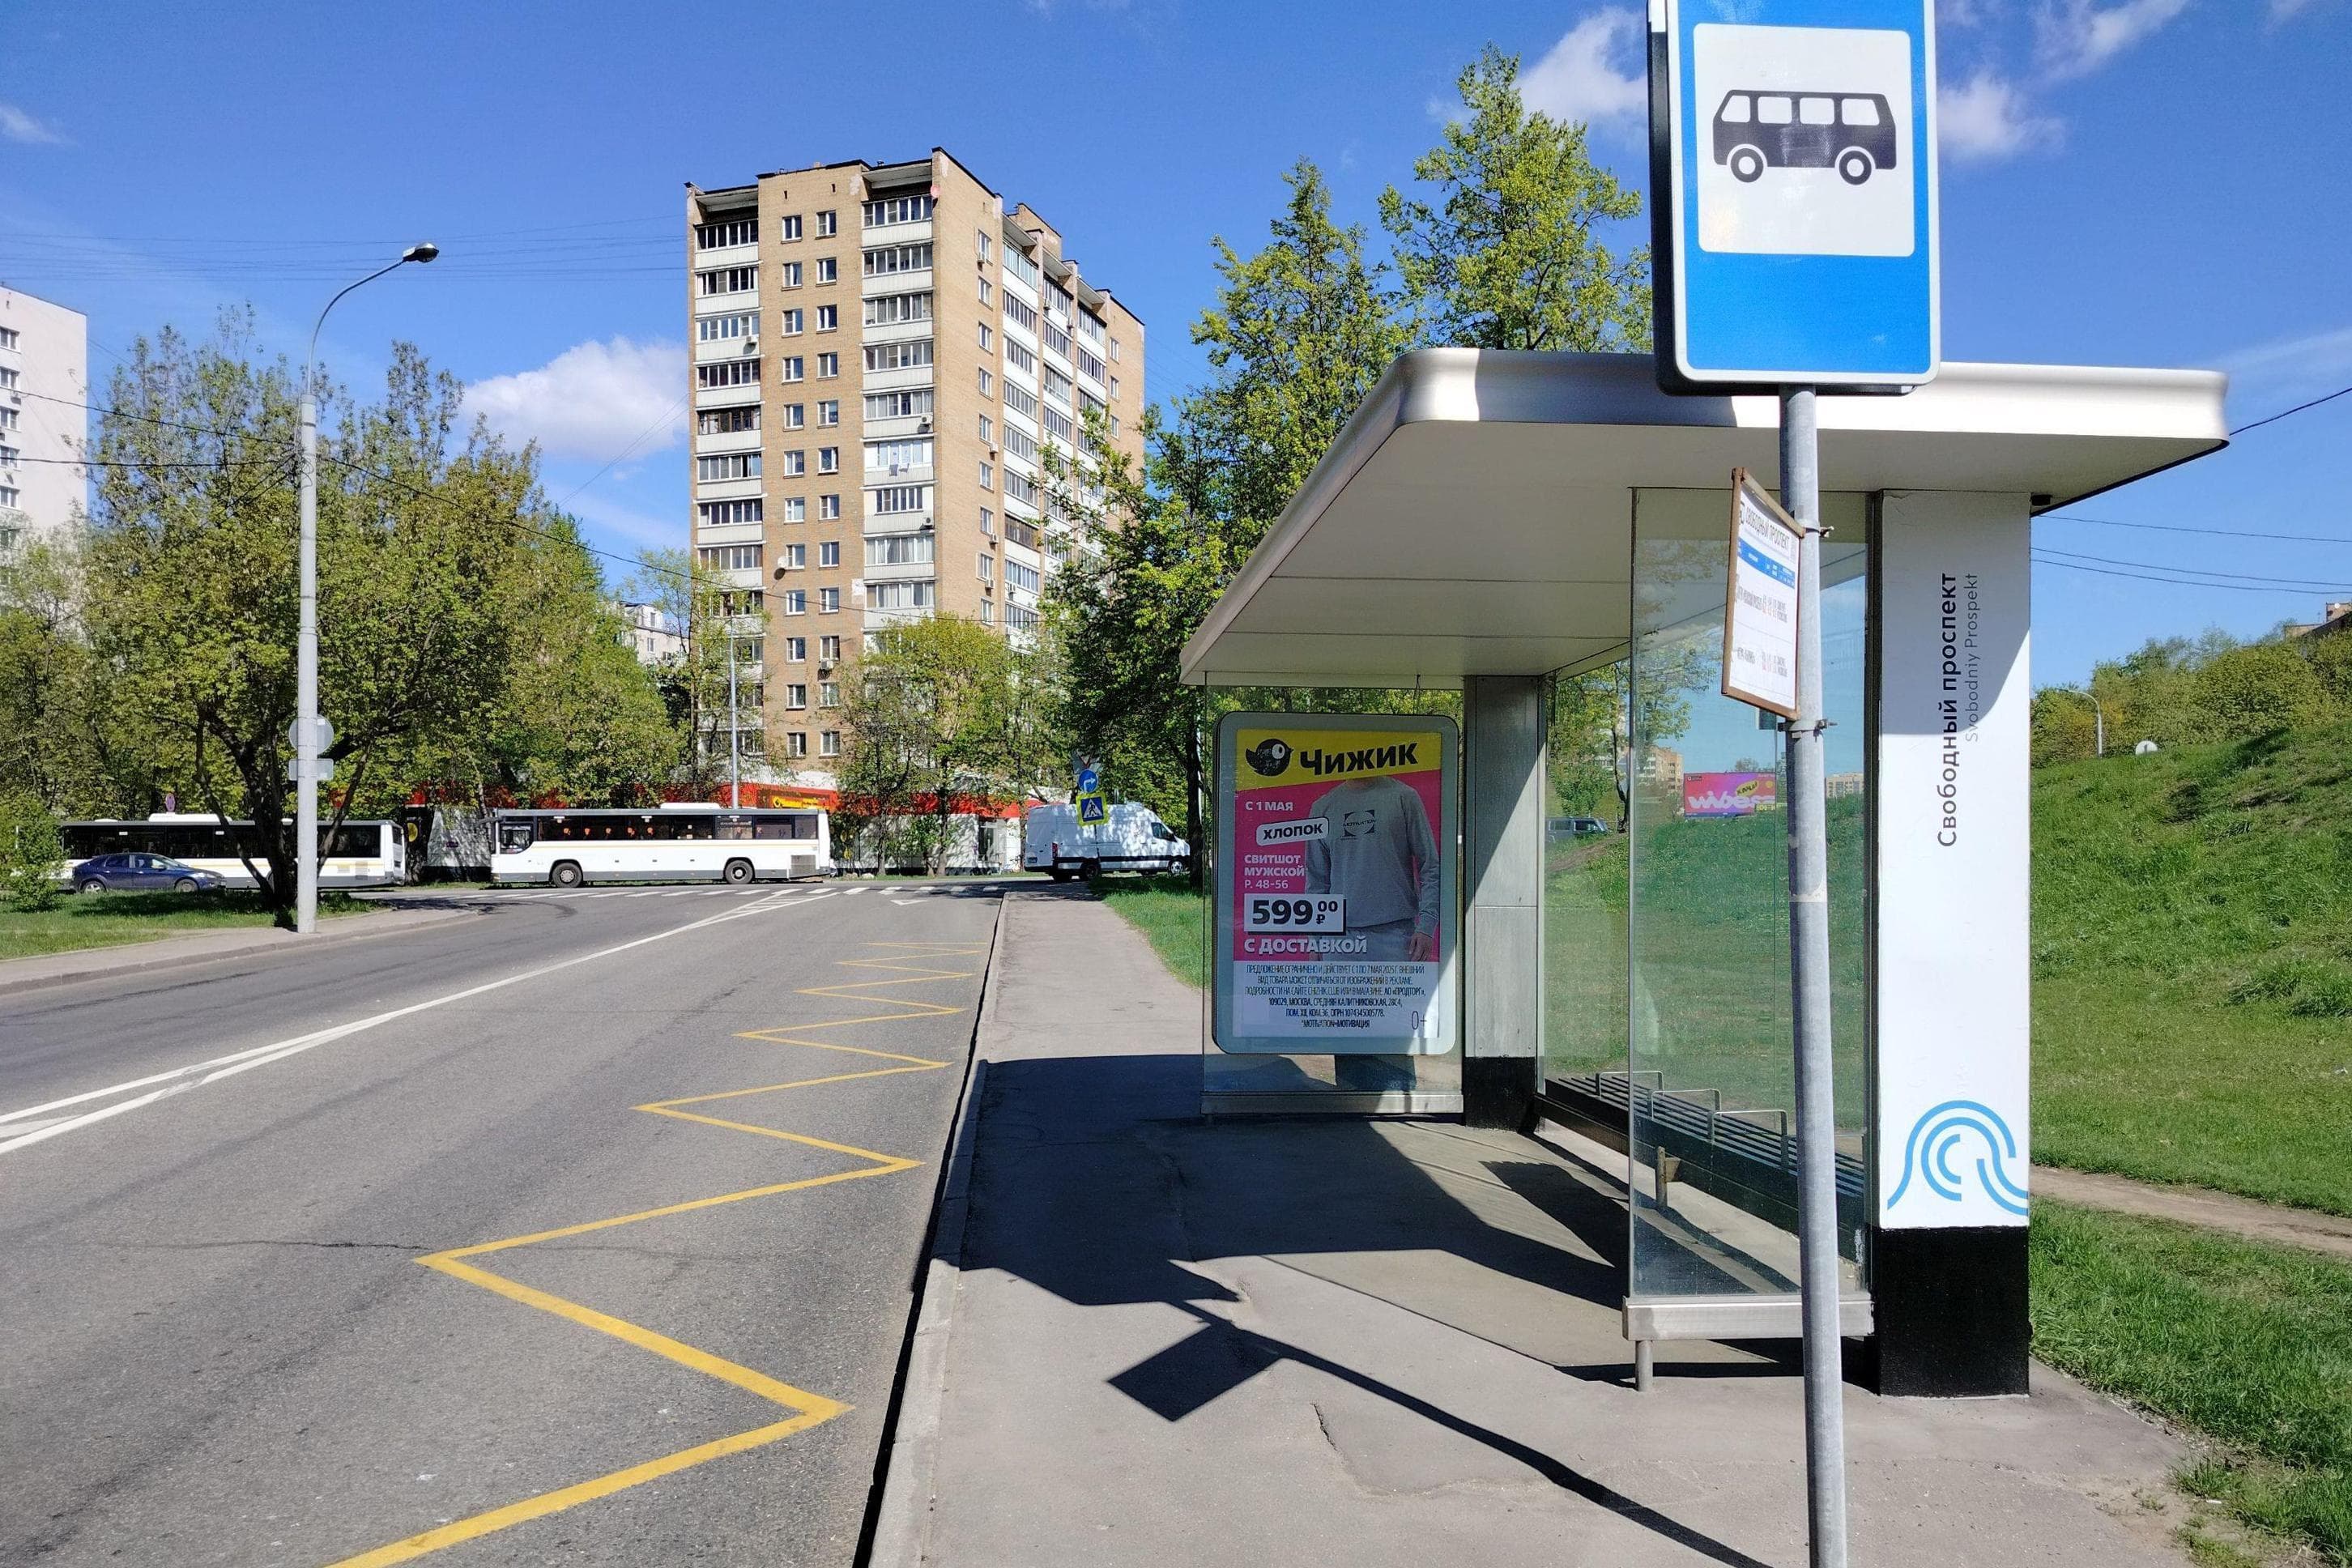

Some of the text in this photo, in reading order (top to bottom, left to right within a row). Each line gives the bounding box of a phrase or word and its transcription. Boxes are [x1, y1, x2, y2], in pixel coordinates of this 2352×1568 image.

[1964, 573, 1981, 743] Svobodniy Prospekt
[1937, 573, 1962, 847] Свободный проспект
[1245, 801, 1293, 812] С 1 МАЯ
[1263, 823, 1323, 840] ХЛОПОК
[1244, 854, 1302, 864] СВИТШОТ
[1244, 865, 1306, 876] МУЖСКОЙ
[1244, 880, 1289, 889] Р. 48-56
[1252, 899, 1338, 925] 599 00
[1244, 935, 1367, 955] С ДОСТАВКОЙ
[1411, 1011, 1427, 1030] 0+
